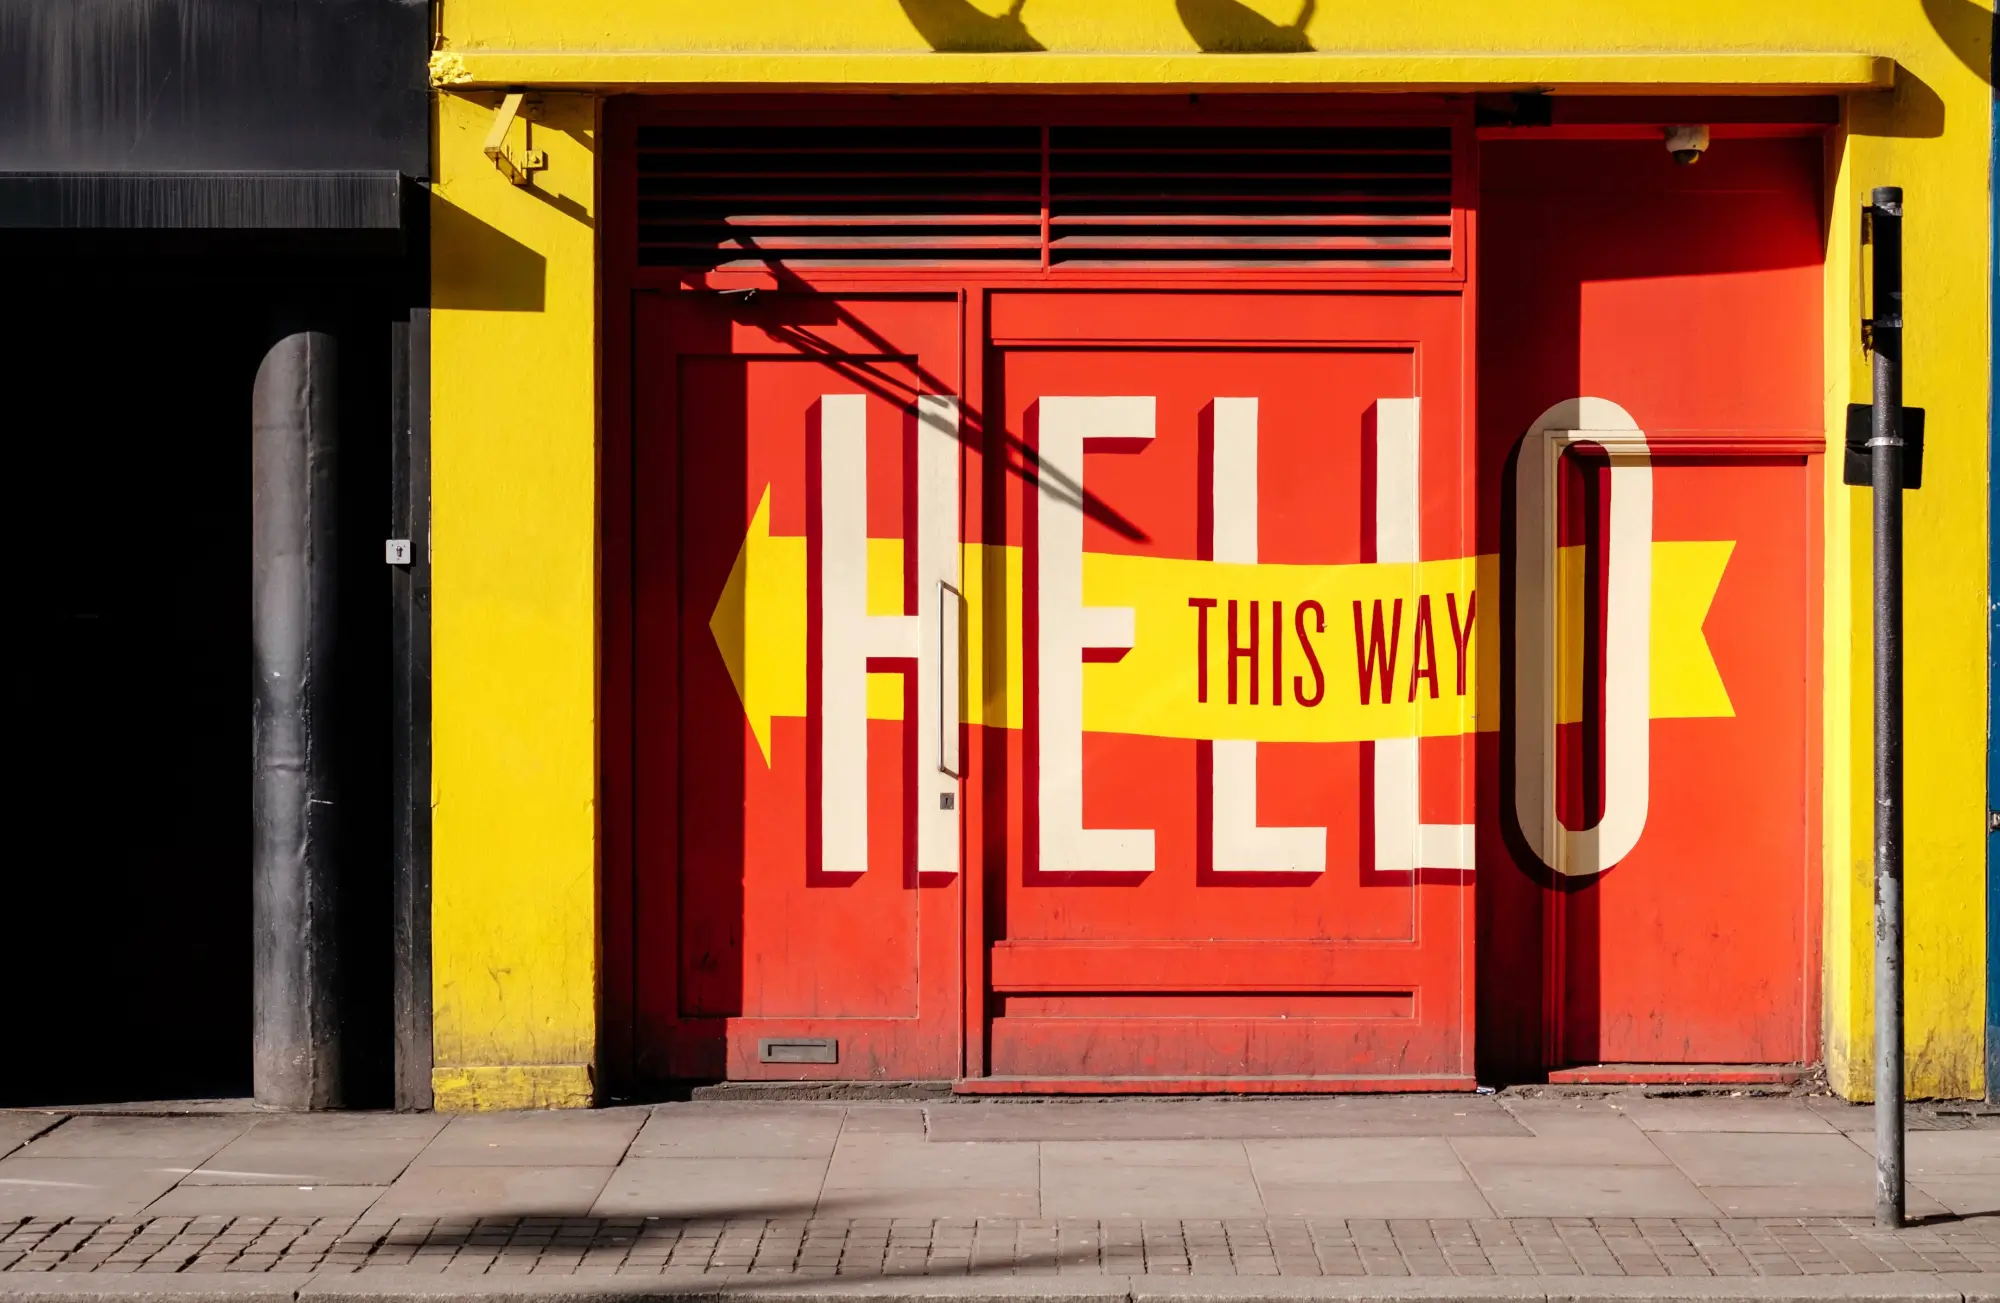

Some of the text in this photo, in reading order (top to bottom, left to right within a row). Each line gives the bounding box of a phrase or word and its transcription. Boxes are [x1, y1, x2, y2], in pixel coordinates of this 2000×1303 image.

[819, 394, 1653, 877] HELLO
[1188, 589, 1477, 708] THIS WAY
